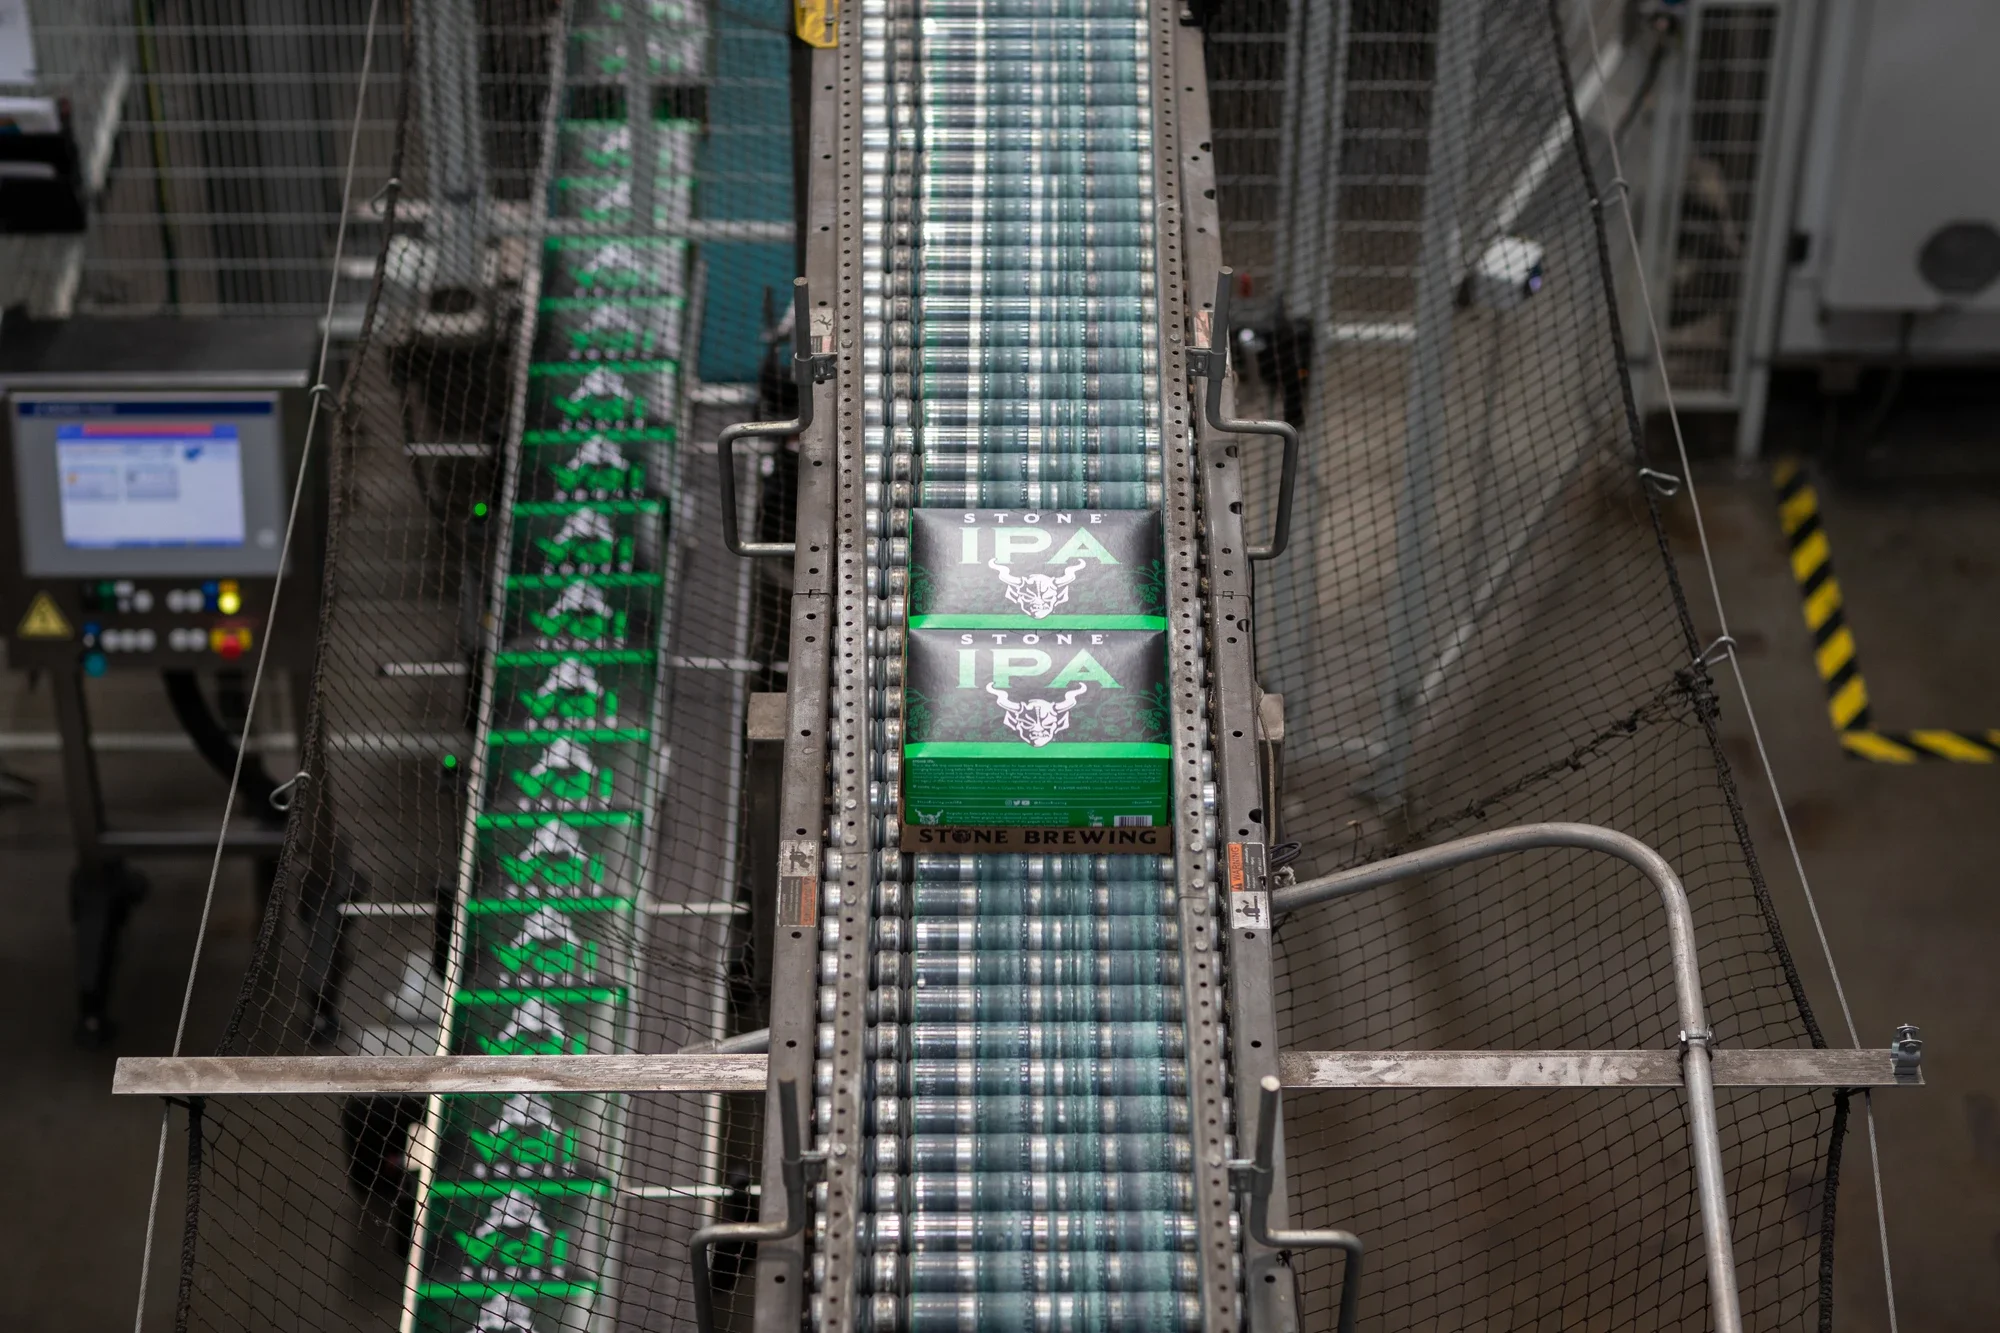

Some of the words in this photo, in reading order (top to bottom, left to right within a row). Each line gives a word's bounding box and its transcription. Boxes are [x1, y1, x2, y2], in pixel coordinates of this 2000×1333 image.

[963, 512, 1103, 524] STONE
[958, 526, 1122, 565] IPA
[960, 633, 1104, 645] STONE
[955, 648, 1125, 689] IPA
[919, 828, 1009, 844] STONE
[1024, 829, 1158, 845] BREWING
[1230, 846, 1242, 882] WARNING
